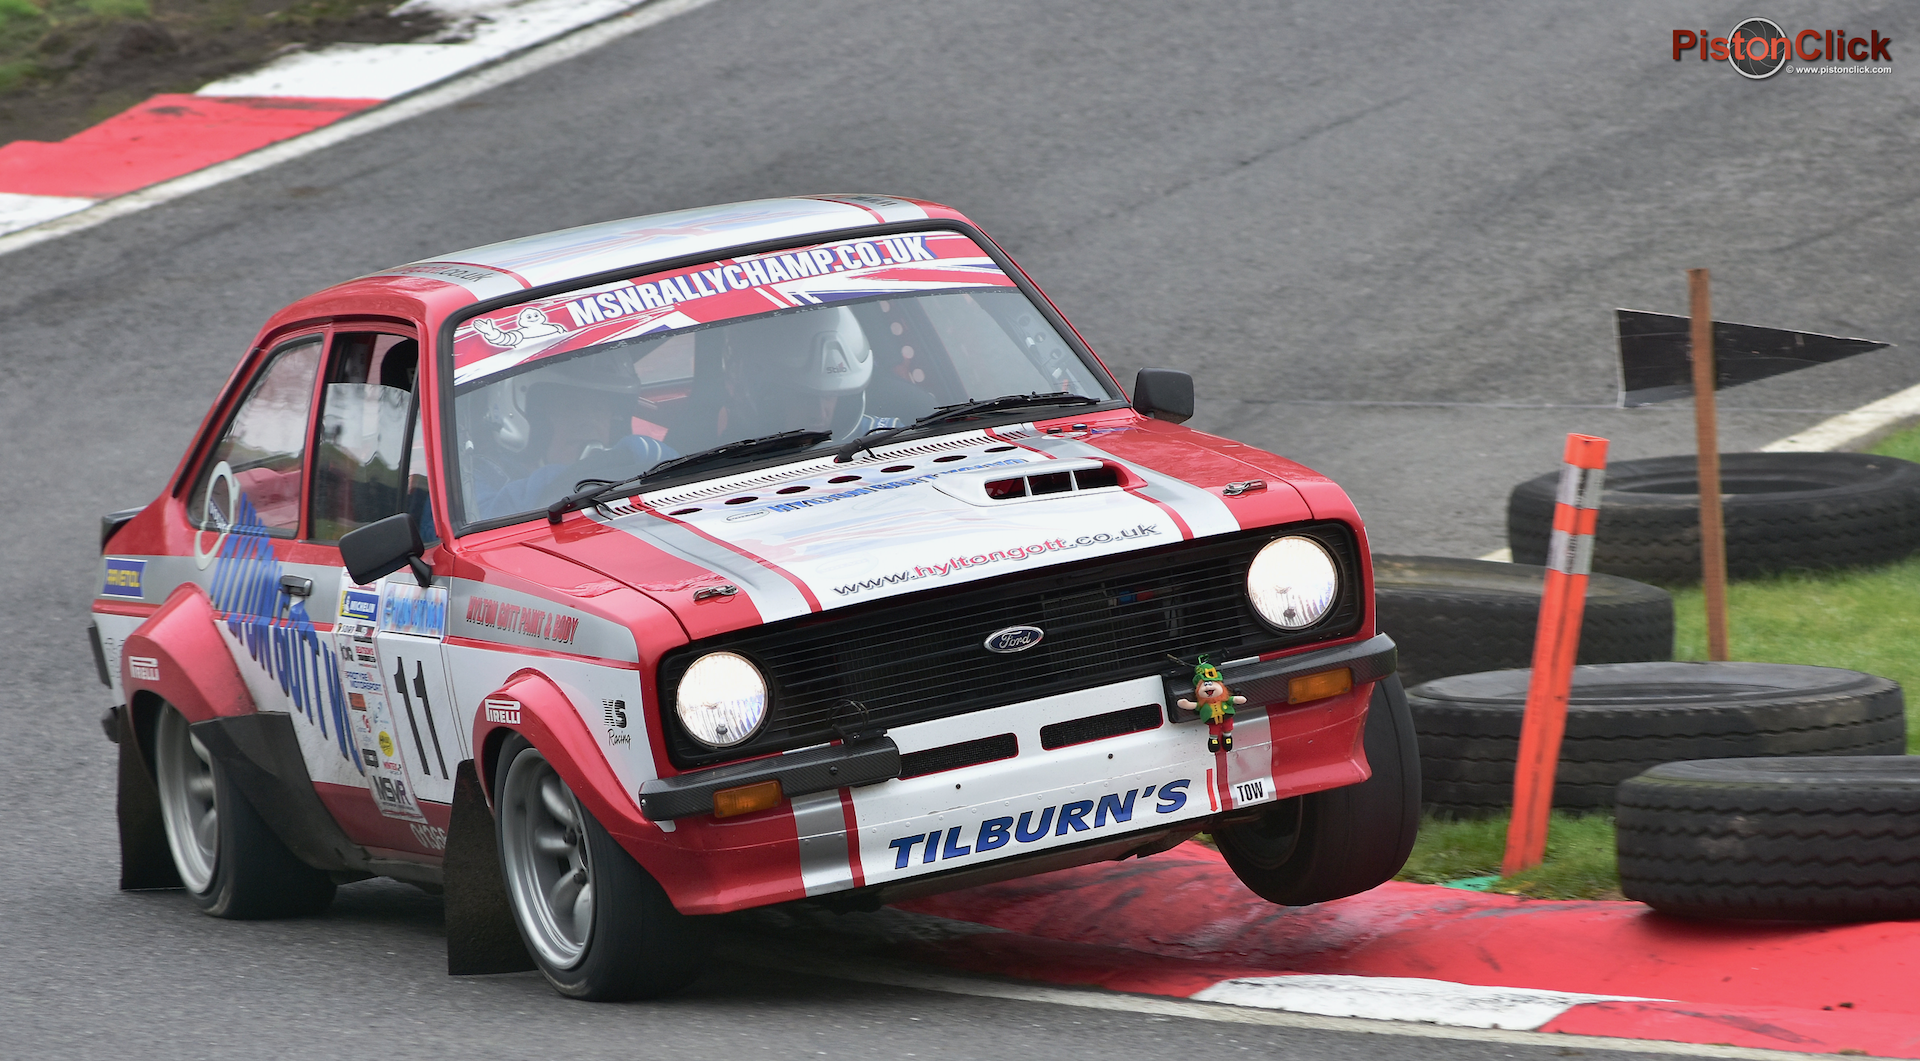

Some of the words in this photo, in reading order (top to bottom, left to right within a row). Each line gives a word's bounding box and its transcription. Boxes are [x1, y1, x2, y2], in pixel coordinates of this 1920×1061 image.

[565, 235, 937, 327] MSNRALLYCHAMP.CO.UK
[833, 523, 1159, 596] www.hyltongott.co.uk
[350, 600, 376, 613] MICHELIN
[466, 595, 499, 628] HYLTON
[497, 602, 521, 633] GOTT
[518, 606, 546, 638] PAINT
[543, 612, 553, 641] &
[552, 613, 579, 645] BODY
[1000, 630, 1032, 649] Ford
[128, 655, 160, 681] PIRELLI
[393, 656, 449, 780] 11
[484, 698, 521, 725] PIRELLI
[607, 728, 632, 750] Racing
[372, 775, 411, 805] MSVR
[1237, 781, 1263, 802] TOW
[889, 778, 1191, 870] TILBURN'S
